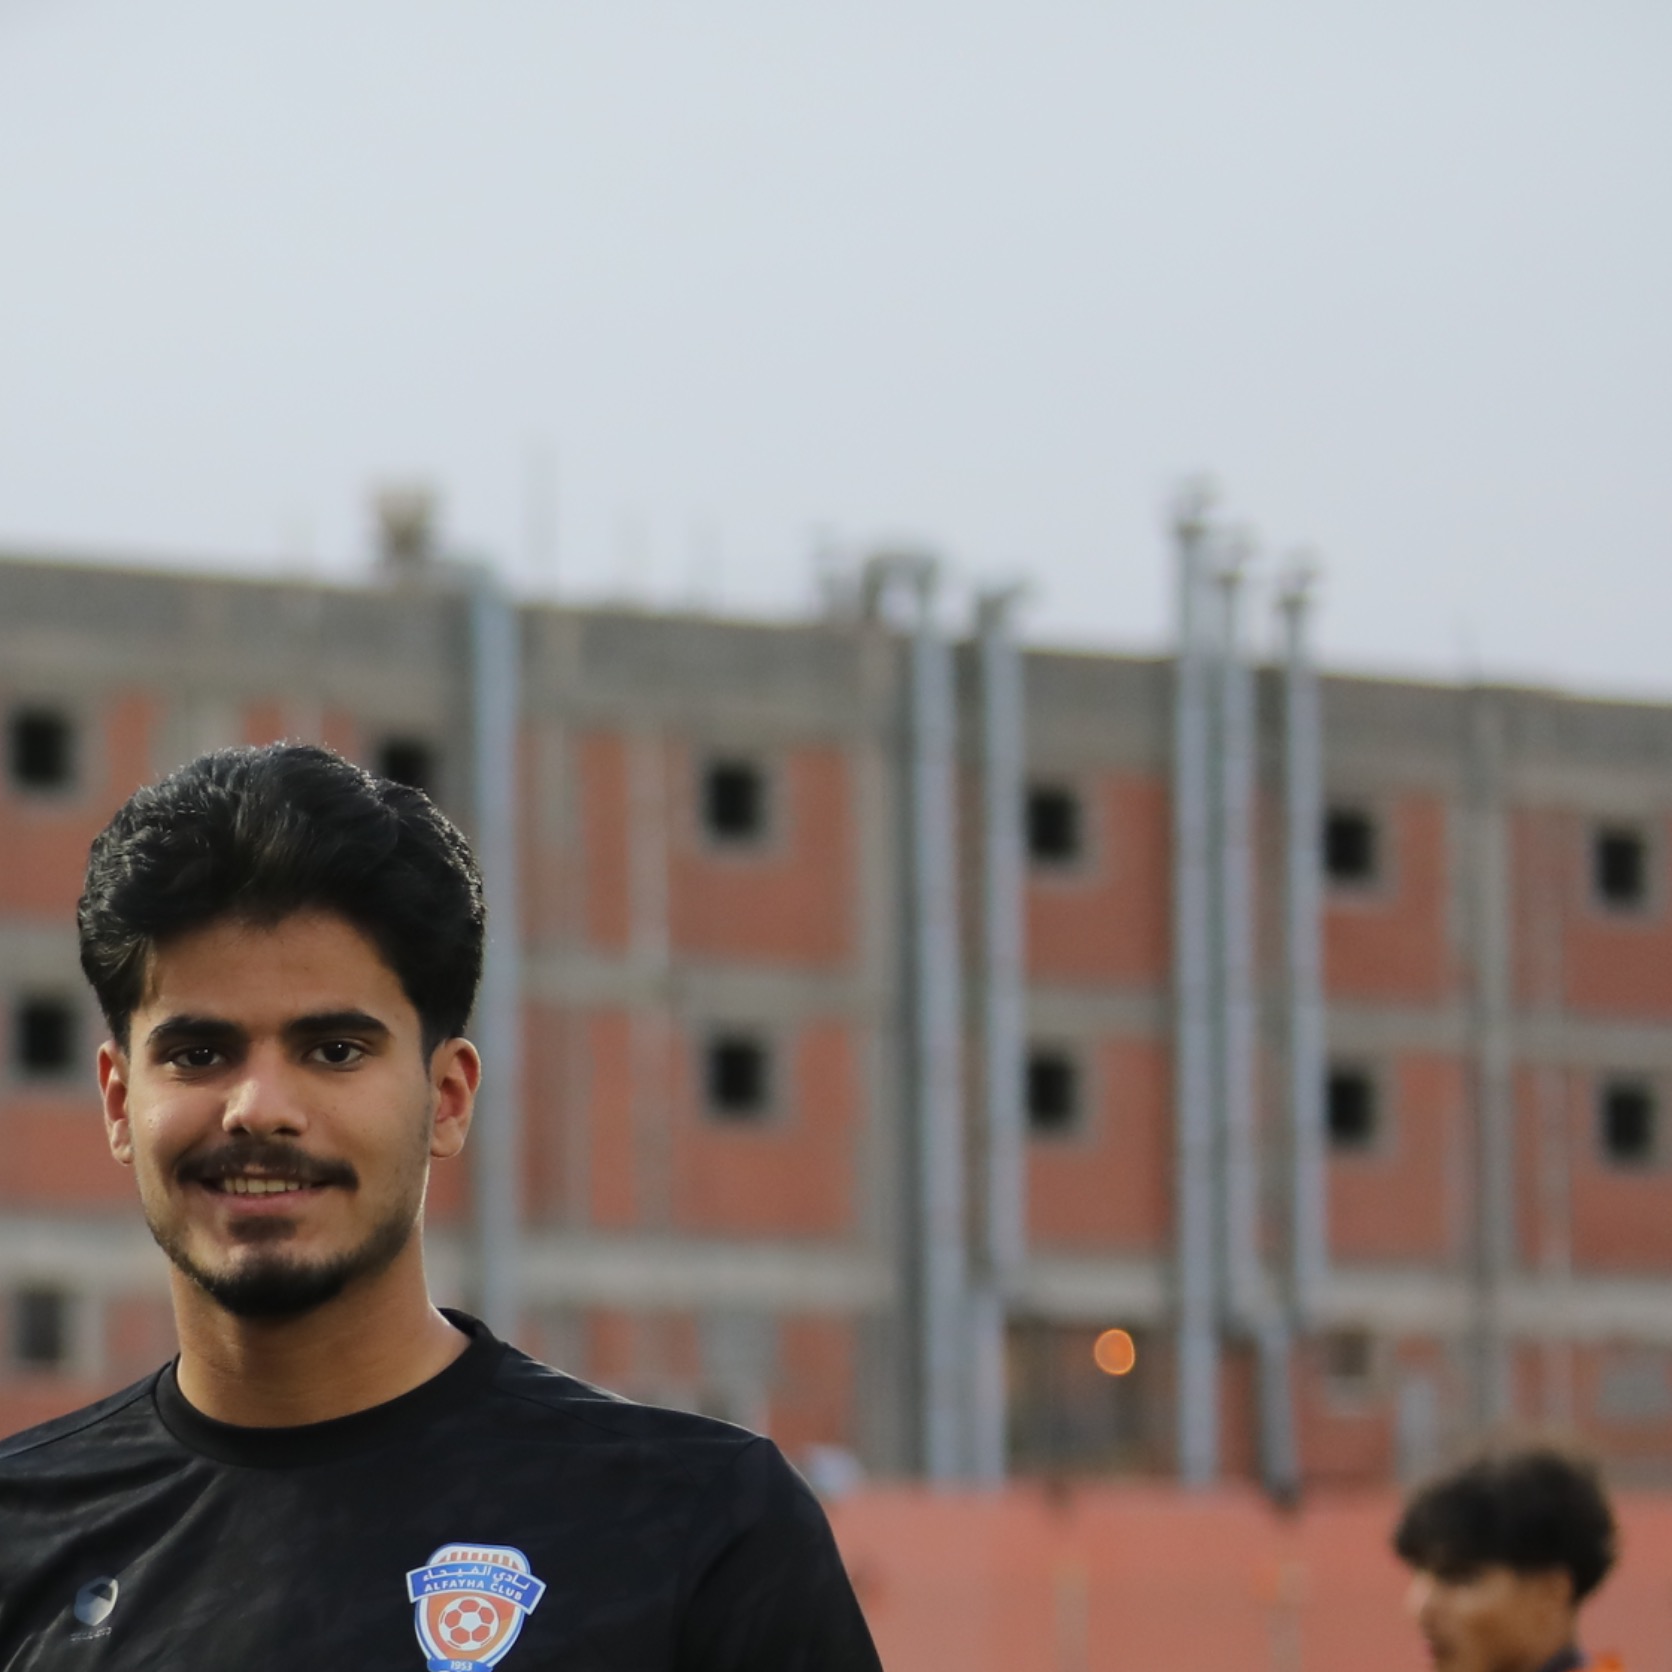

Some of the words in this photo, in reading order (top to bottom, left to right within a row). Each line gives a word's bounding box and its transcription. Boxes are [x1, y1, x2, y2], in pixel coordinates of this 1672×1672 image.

[424, 1579, 484, 1592] ALFAYHA
[490, 1583, 523, 1601] CLUB
[450, 1661, 473, 1671] 1953
